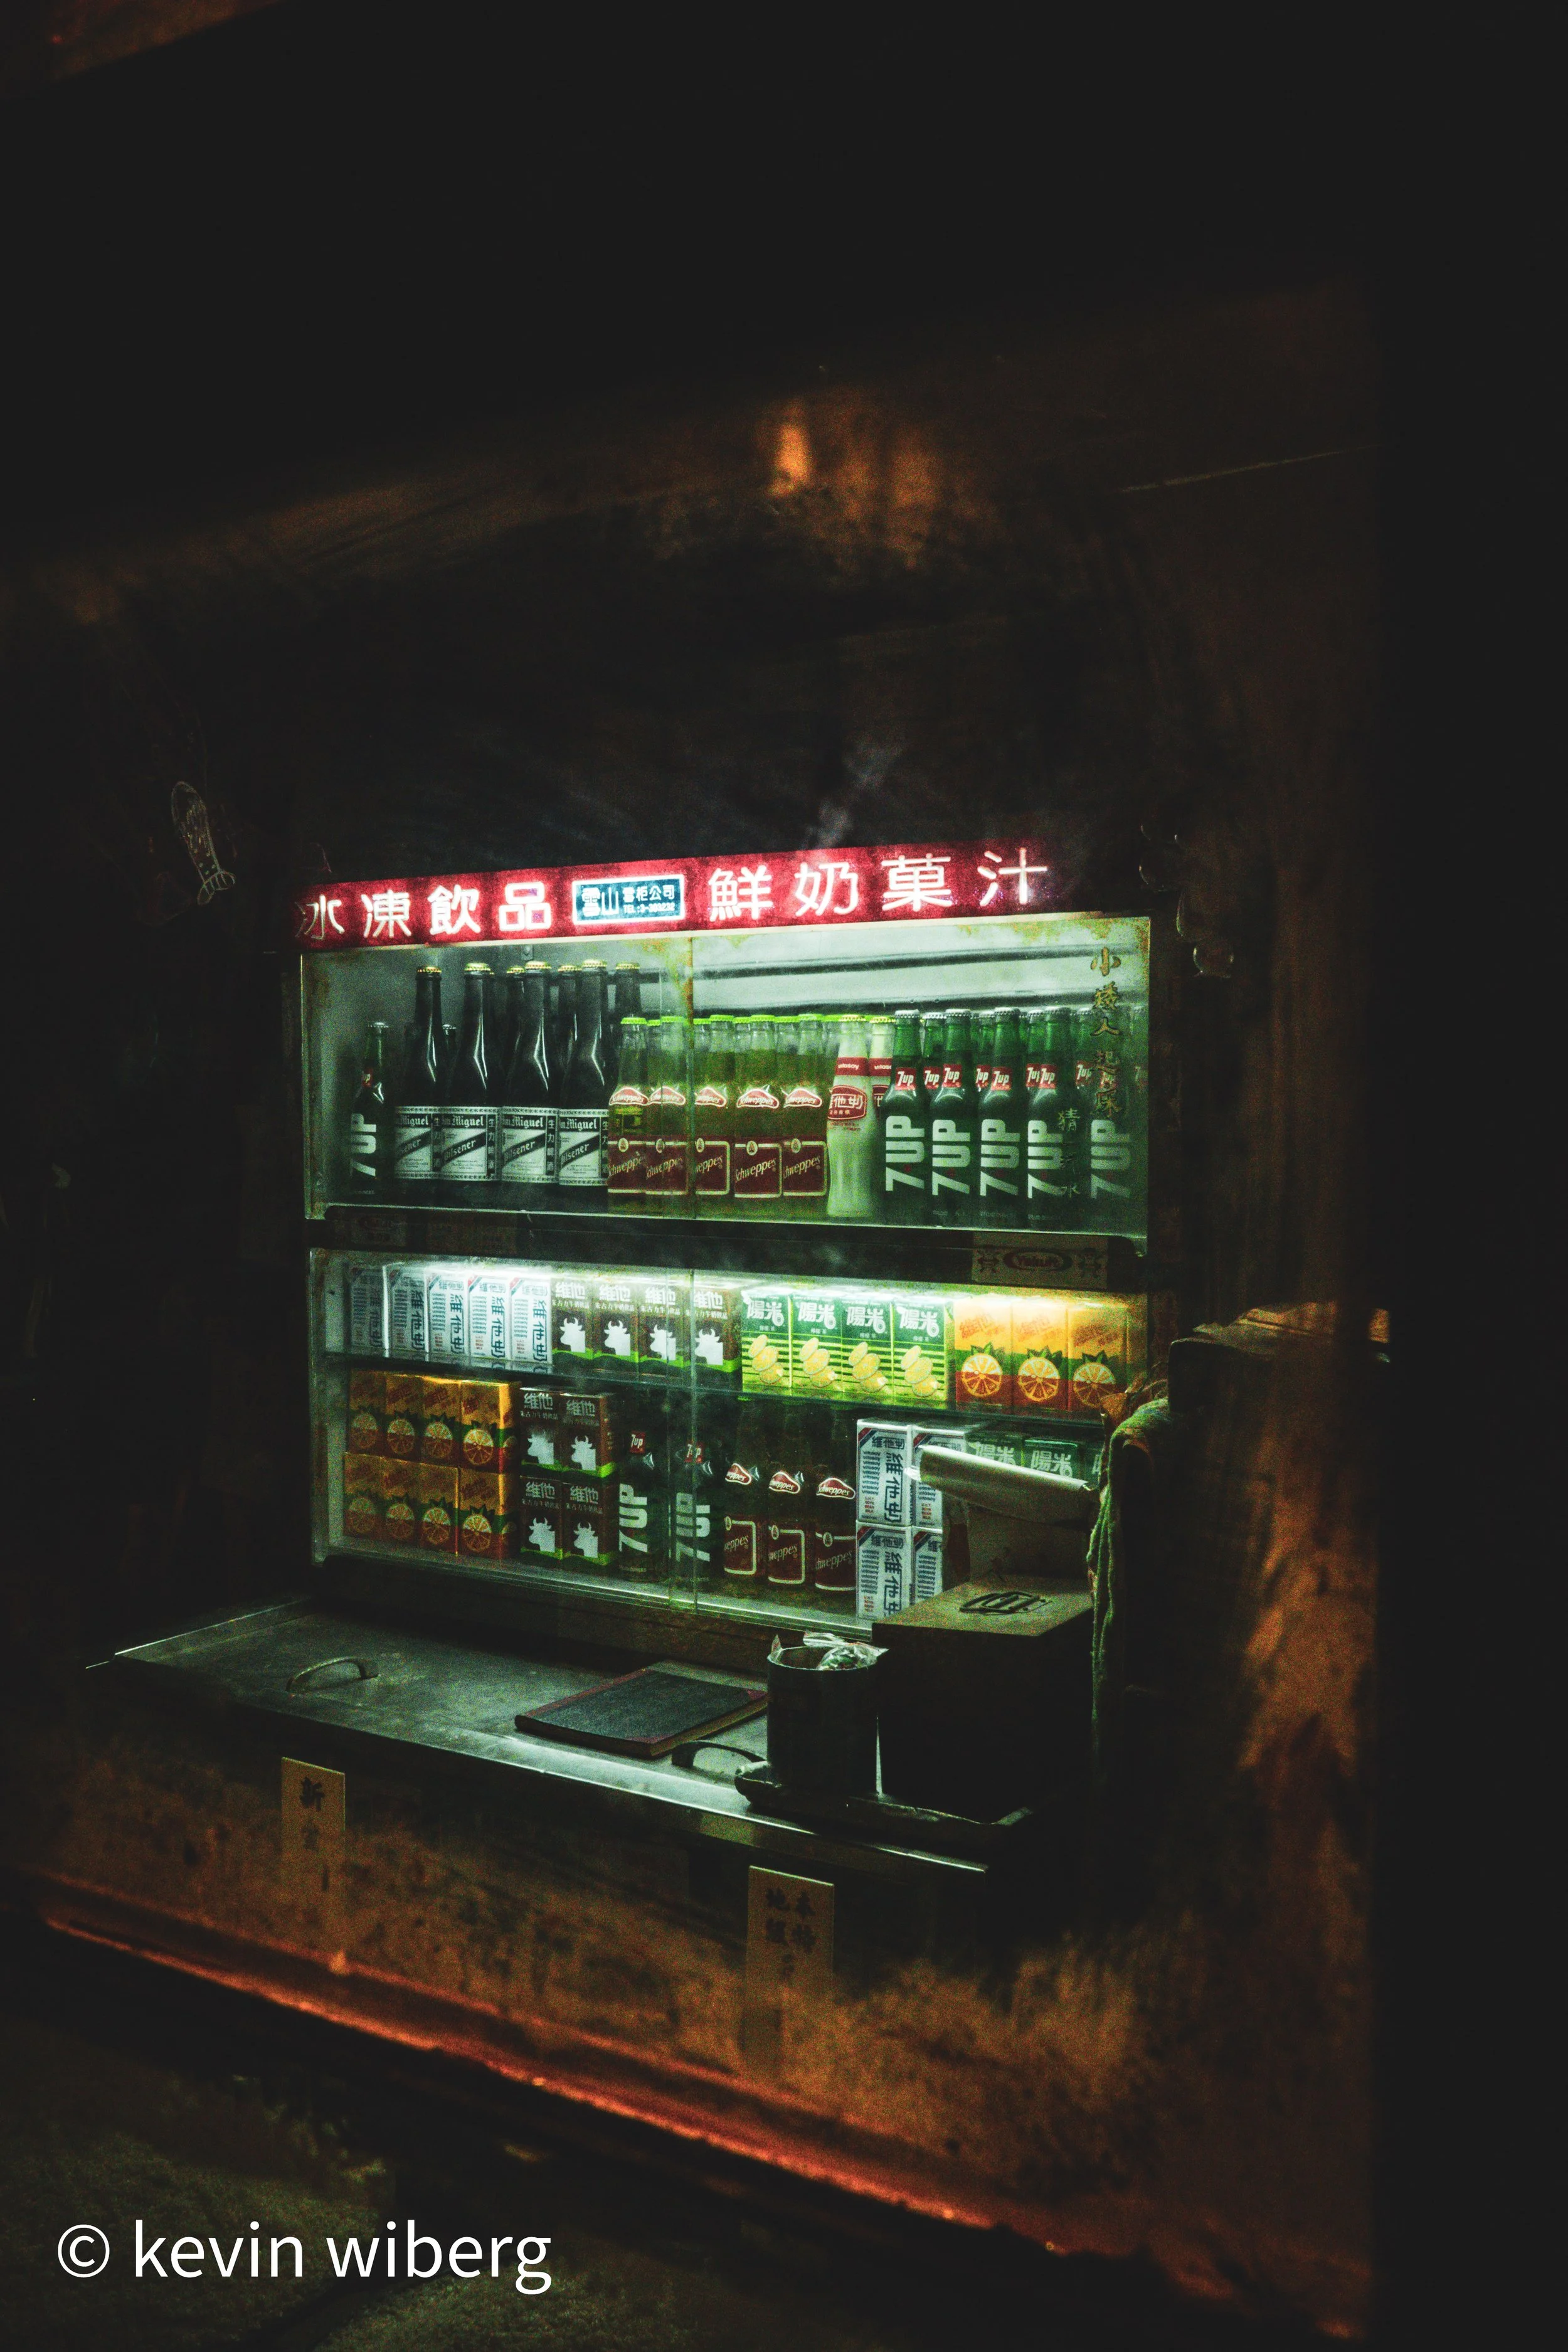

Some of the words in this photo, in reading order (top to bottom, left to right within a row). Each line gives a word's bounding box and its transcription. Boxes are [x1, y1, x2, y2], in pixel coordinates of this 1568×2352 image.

[708, 847, 1049, 921] 鮮奶菓汁
[294, 881, 553, 940] 冰凍飲品
[897, 1070, 914, 1087] 7up
[924, 1070, 940, 1086] 7up
[943, 1067, 960, 1083] 7up
[993, 1070, 1010, 1087] 7up
[1040, 1067, 1056, 1084] 7up
[452, 1114, 484, 1128] Miguel
[512, 1115, 544, 1129] Miguel
[566, 1117, 598, 1131] Miguel
[886, 1115, 925, 1192] 7UP
[932, 1119, 971, 1196] 7UP
[980, 1118, 1020, 1197] 7UP
[1027, 1120, 1063, 1199] 7UP
[1091, 1119, 1130, 1199] 7UP
[735, 1158, 777, 1182] Schweppes
[450, 1293, 465, 1354] 維他奶
[491, 1296, 506, 1359] 維他奶
[746, 1300, 785, 1327] 陽光
[797, 1301, 837, 1330] 陽光
[846, 1306, 886, 1334] 陽光
[899, 1308, 940, 1338] 陽光
[533, 1299, 548, 1362] 維他奶
[523, 1392, 553, 1411] 維他
[566, 1399, 595, 1417] 維他
[631, 1434, 644, 1449] 7up
[1030, 1450, 1073, 1478] 陽光
[526, 1481, 556, 1500] 維他
[569, 1485, 599, 1505] 維他
[884, 1452, 904, 1523] 維他奶
[618, 1482, 648, 1553] 7UP
[675, 1491, 711, 1562] 7UP
